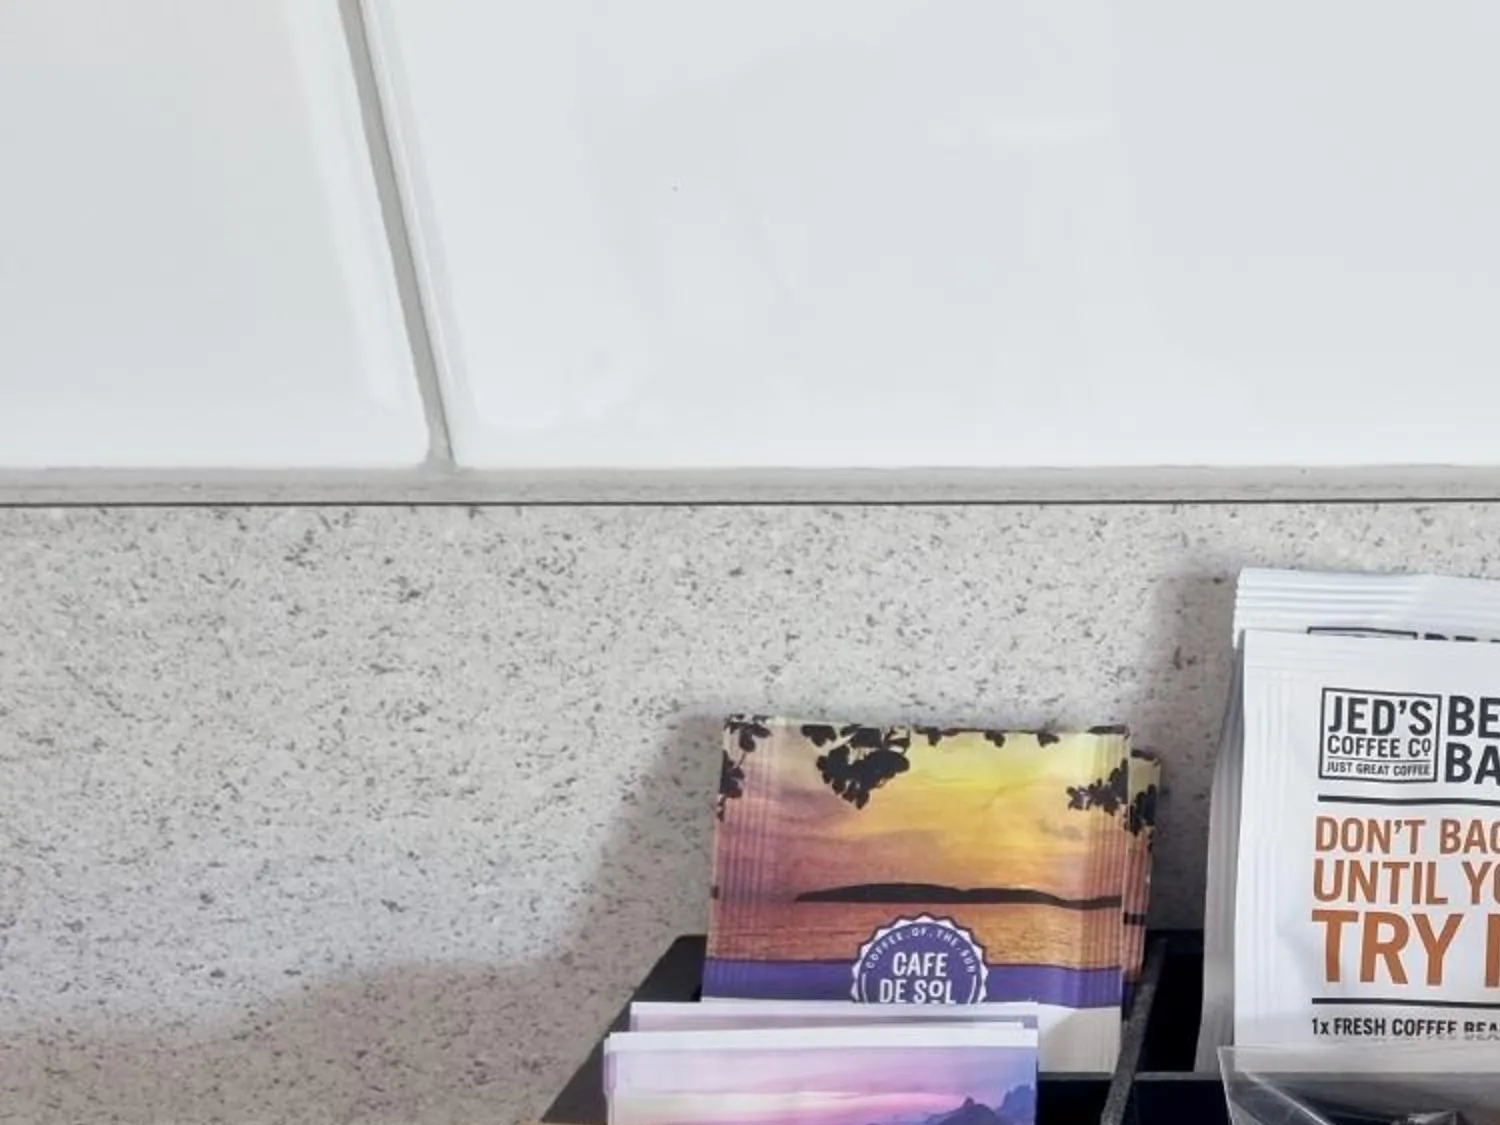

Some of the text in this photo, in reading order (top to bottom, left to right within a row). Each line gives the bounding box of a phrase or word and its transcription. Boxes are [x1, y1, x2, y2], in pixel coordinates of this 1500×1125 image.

[1328, 696, 1433, 737] JED'S
[1327, 735, 1400, 758] COFFEE
[1326, 762, 1430, 776] JUST GREAT COFFEE
[1314, 816, 1426, 854] DON'T
[1313, 858, 1448, 904] UNTIL
[1312, 910, 1464, 986] TRY
[892, 951, 949, 977] CAFE
[879, 979, 907, 1003] DE
[1312, 1018, 1329, 1036] 1x
[1333, 1018, 1386, 1037] FRESH
